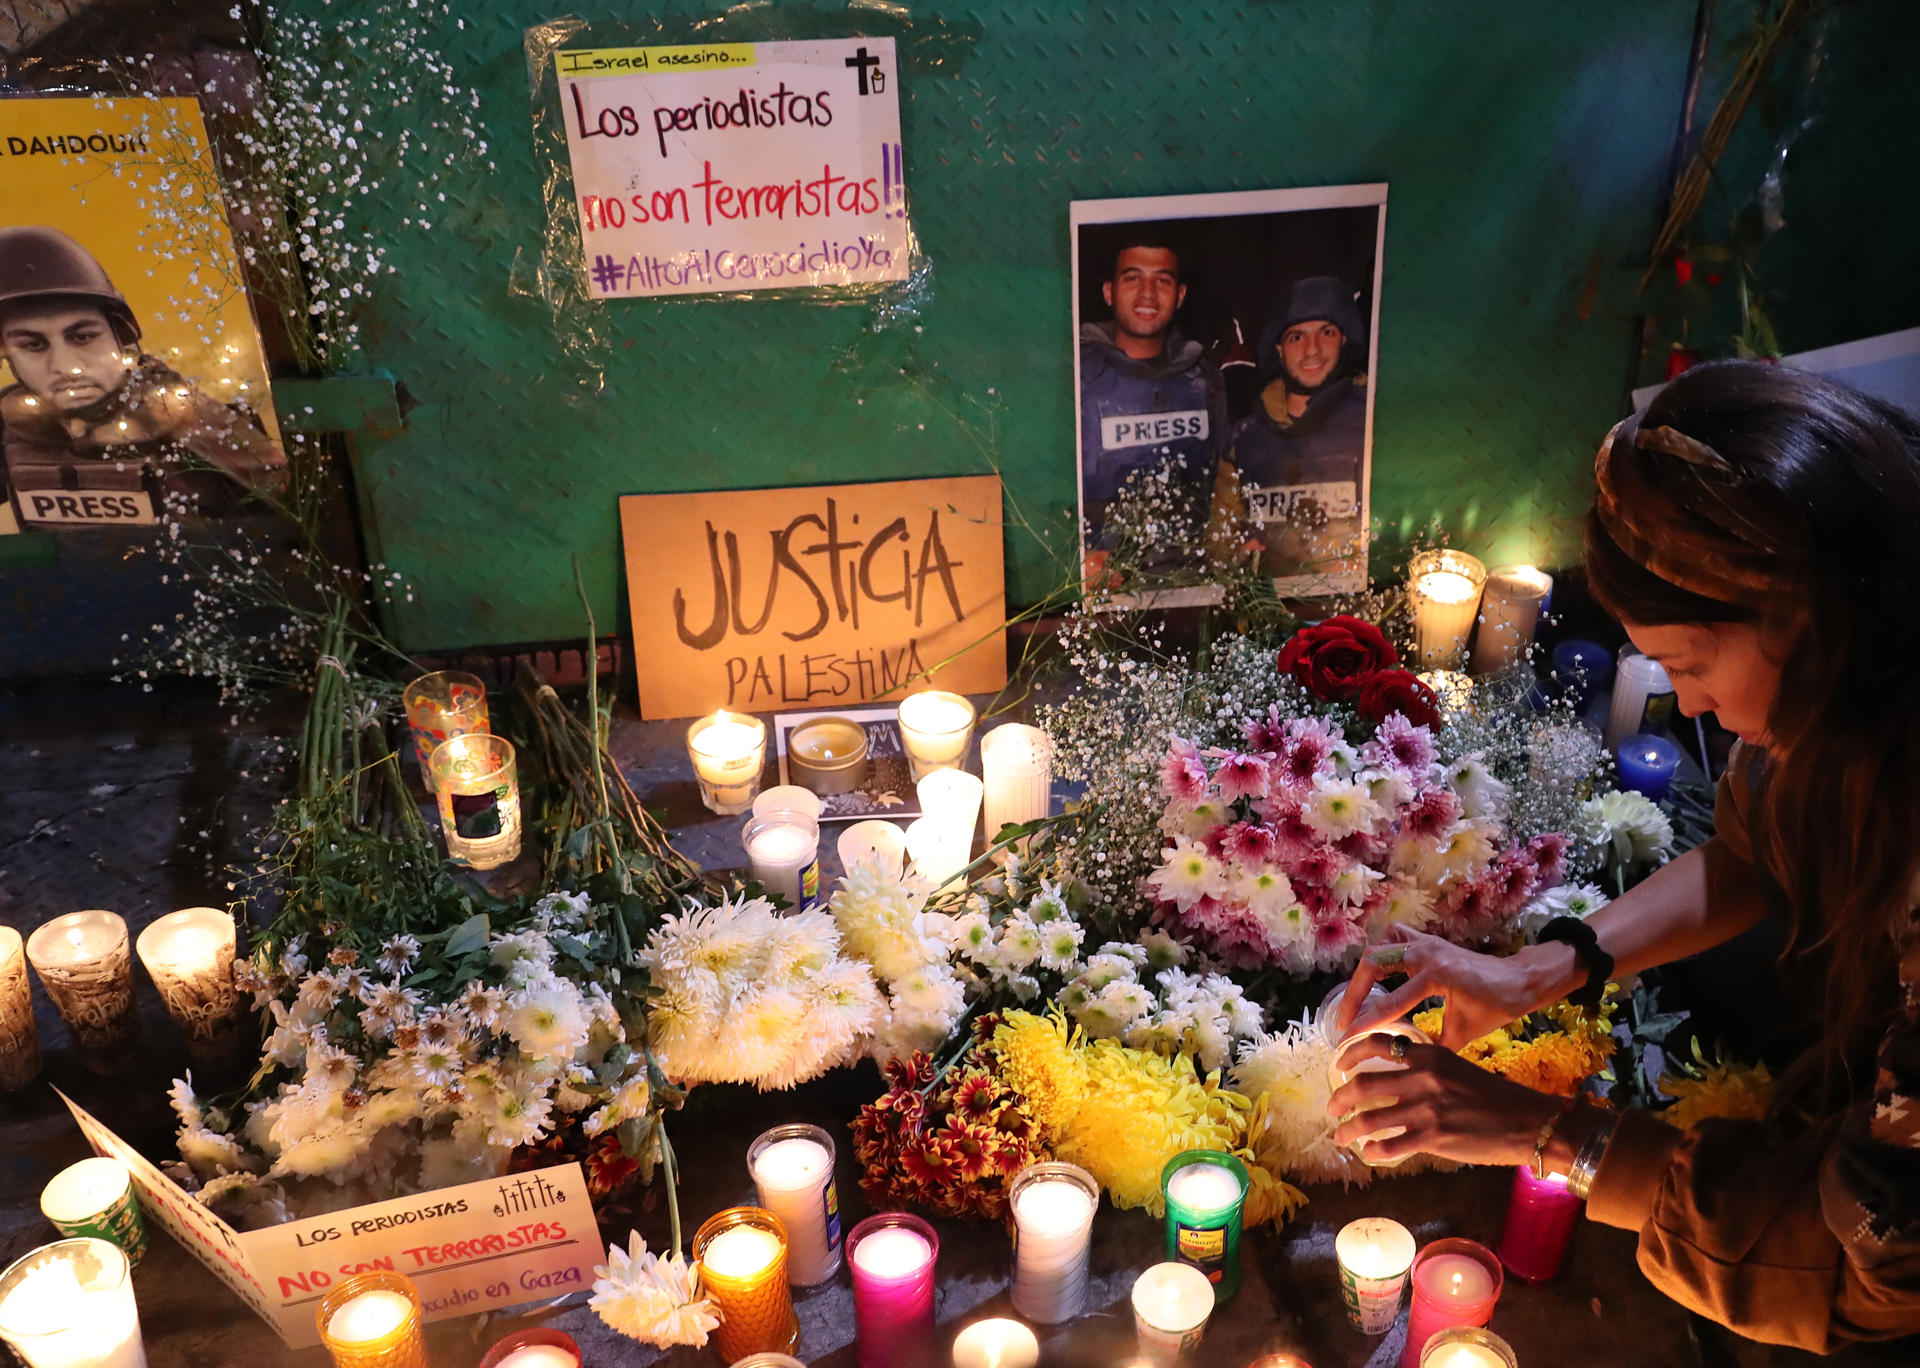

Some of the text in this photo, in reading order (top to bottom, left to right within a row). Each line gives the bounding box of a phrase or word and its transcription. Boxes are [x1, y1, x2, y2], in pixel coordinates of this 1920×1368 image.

[562, 50, 747, 73] Israel asesino...
[570, 81, 834, 158] Los periodistas
[582, 194, 626, 232] no
[631, 187, 690, 224] son
[1115, 416, 1202, 443] PRESS
[31, 495, 140, 518] PRESS
[295, 1199, 469, 1248] LOS PERIODISTAS
[277, 1270, 332, 1299] NO
[401, 1221, 568, 1268] TERRORISTAS
[484, 1281, 510, 1298] en
[519, 1266, 583, 1291] Gaza
